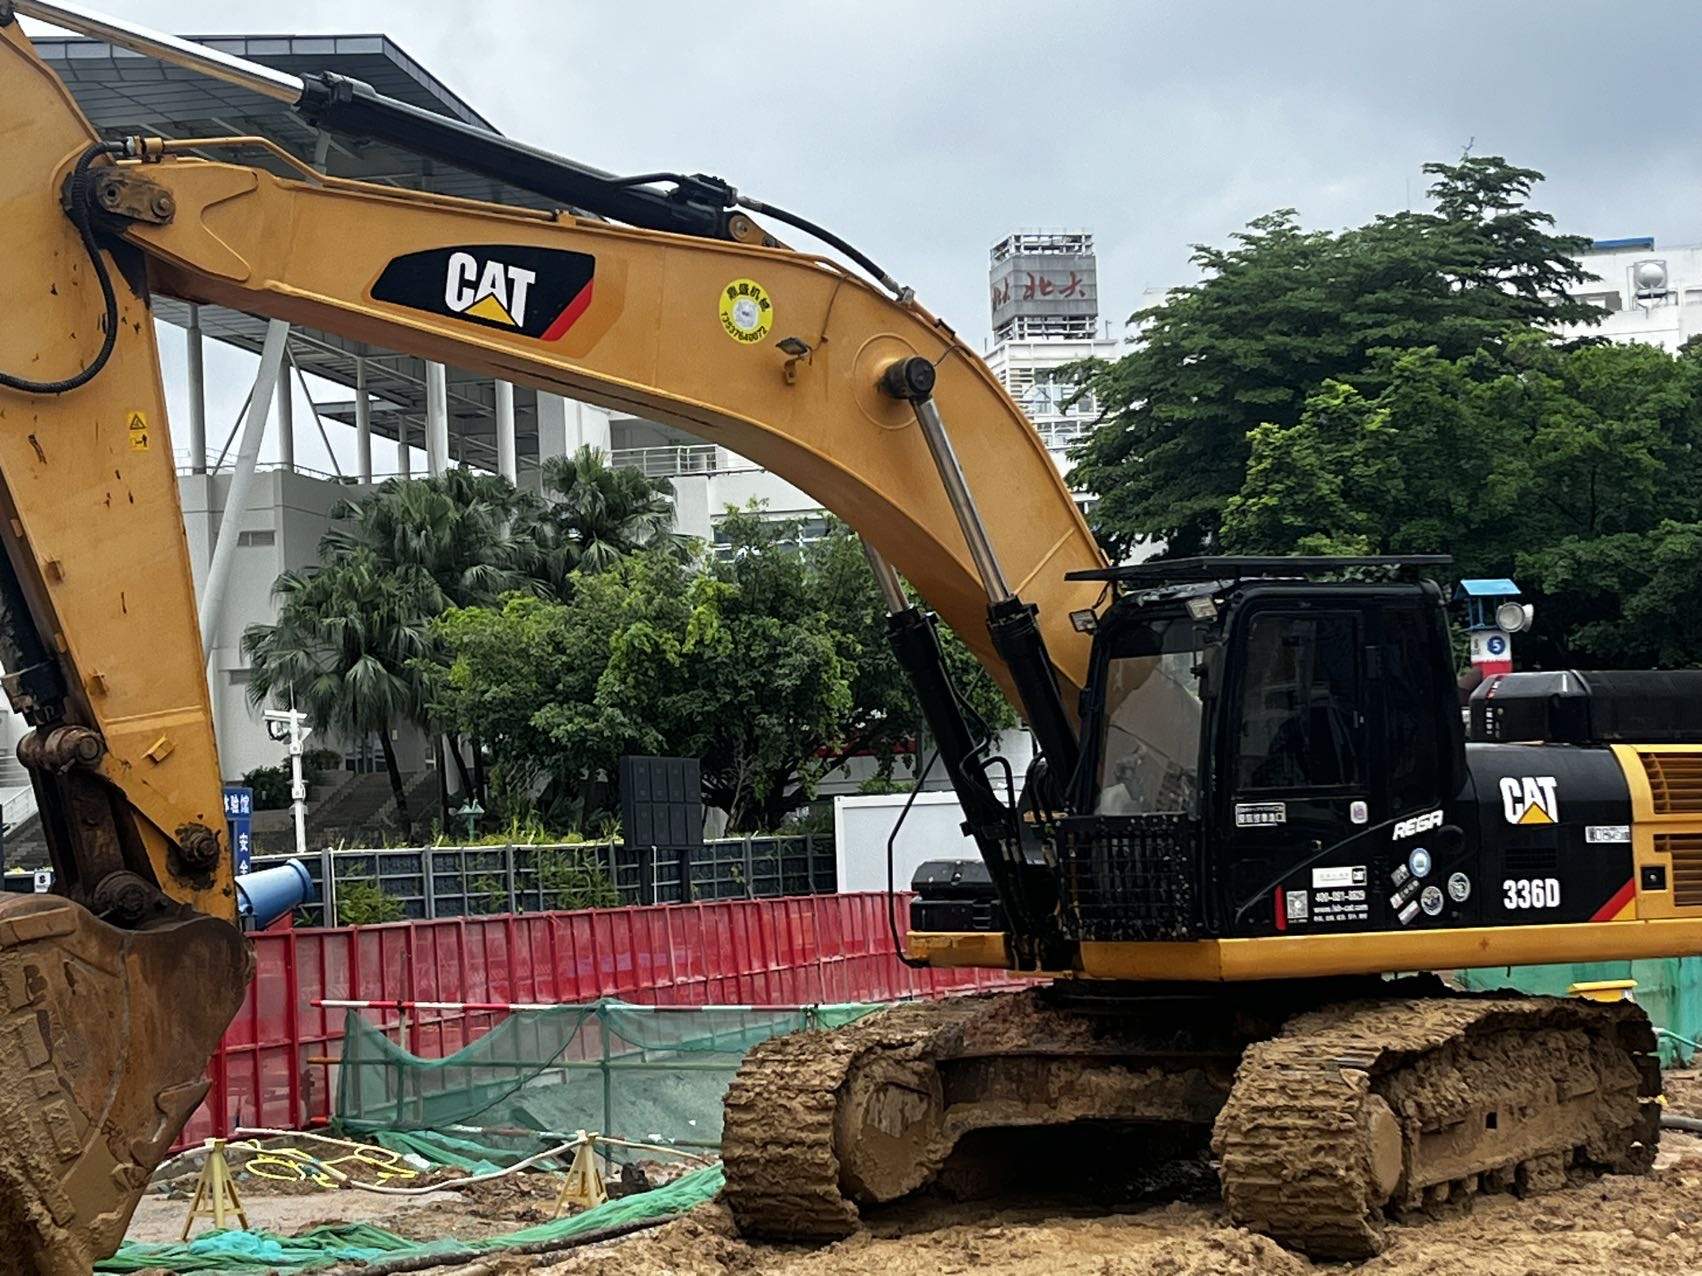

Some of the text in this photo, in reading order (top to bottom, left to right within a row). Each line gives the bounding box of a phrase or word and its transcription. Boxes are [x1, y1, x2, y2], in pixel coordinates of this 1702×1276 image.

[444, 252, 536, 328] CAT
[1499, 776, 1559, 825] CAT
[1503, 878, 1560, 910] 336D
